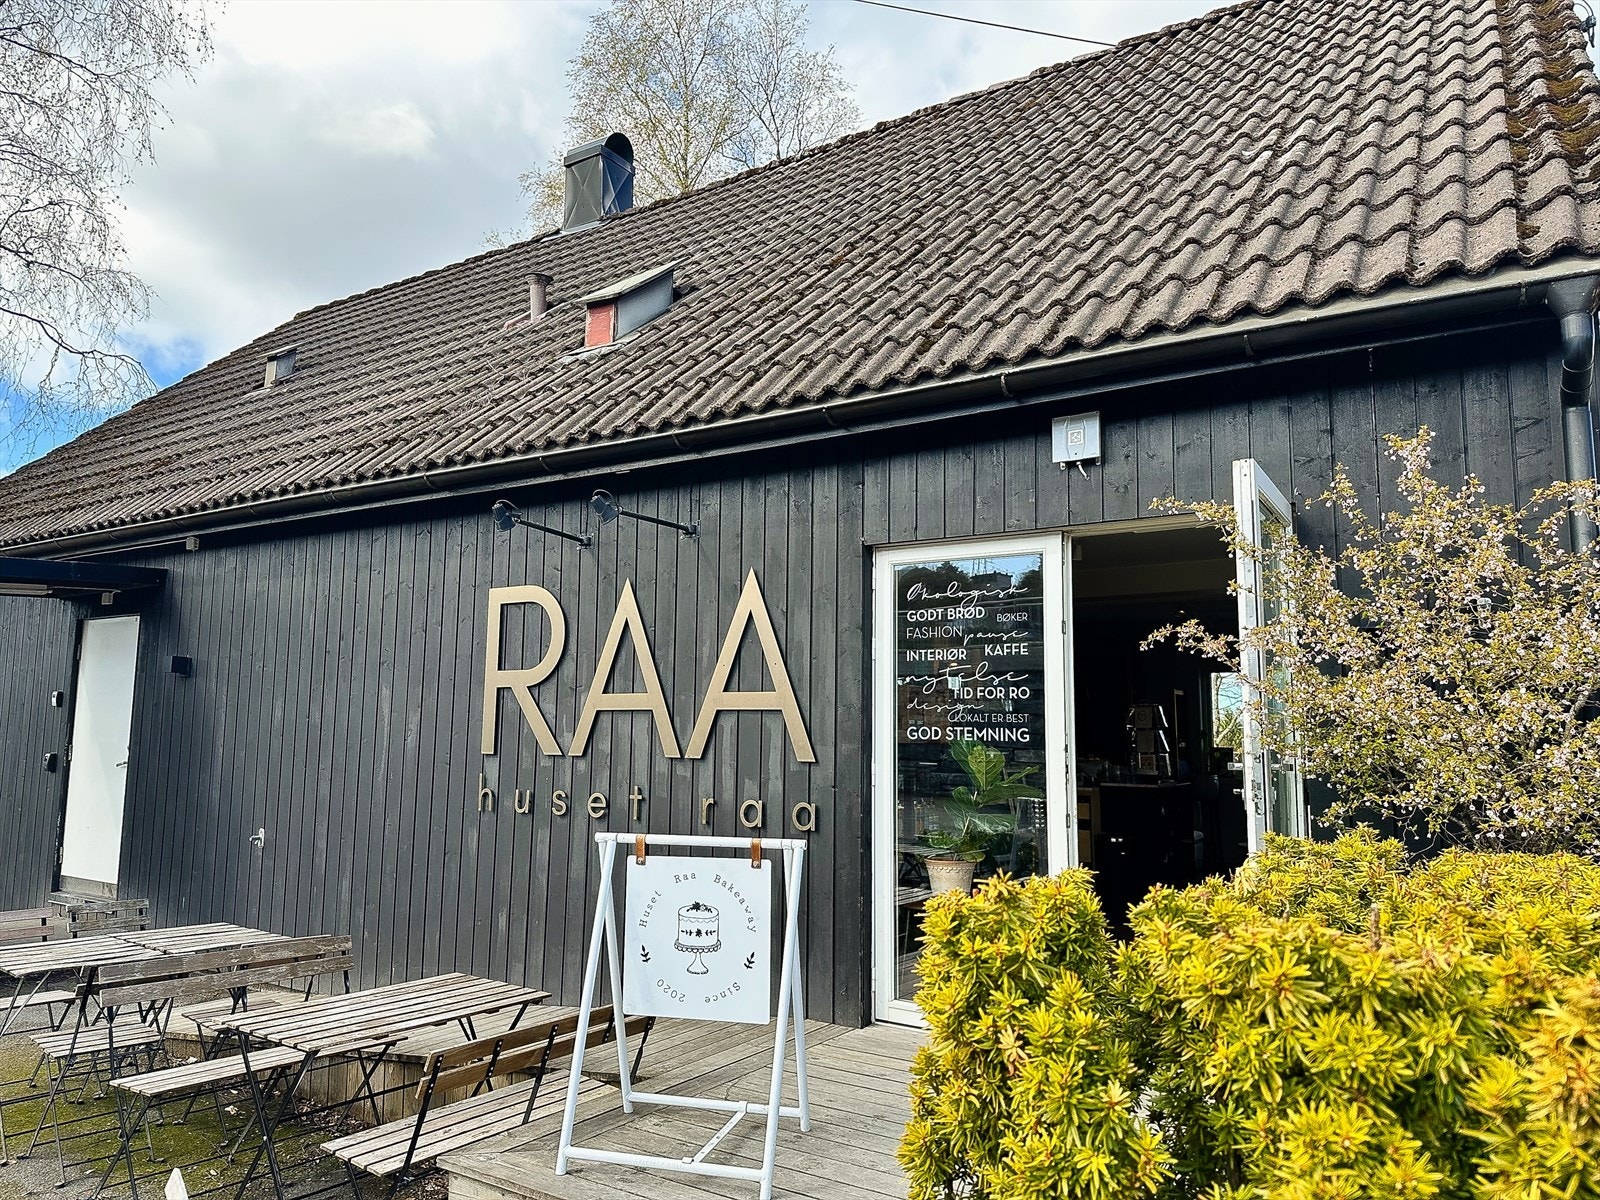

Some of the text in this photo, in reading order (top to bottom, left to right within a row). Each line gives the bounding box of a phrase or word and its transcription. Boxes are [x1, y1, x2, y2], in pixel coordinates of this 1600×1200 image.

[907, 581, 1028, 609] Økologisk
[907, 607, 985, 622] GODT BRØD
[997, 613, 1028, 622] BØKER
[907, 626, 963, 639] FASHION
[964, 630, 1028, 646] pause
[906, 648, 967, 661] INTERIØR
[984, 643, 1028, 656] KAFFE
[481, 566, 816, 763] RAA
[905, 661, 1028, 694] nytelse
[953, 687, 1030, 699] TID FOR RO
[907, 698, 984, 722] design
[955, 714, 1029, 723] LOKALT ER BEST
[907, 726, 1030, 742] GOD STEMNING
[478, 773, 816, 832] huset raa
[639, 872, 757, 933] Huset Raa Bakeaway
[656, 978, 741, 1004] Since 2020
